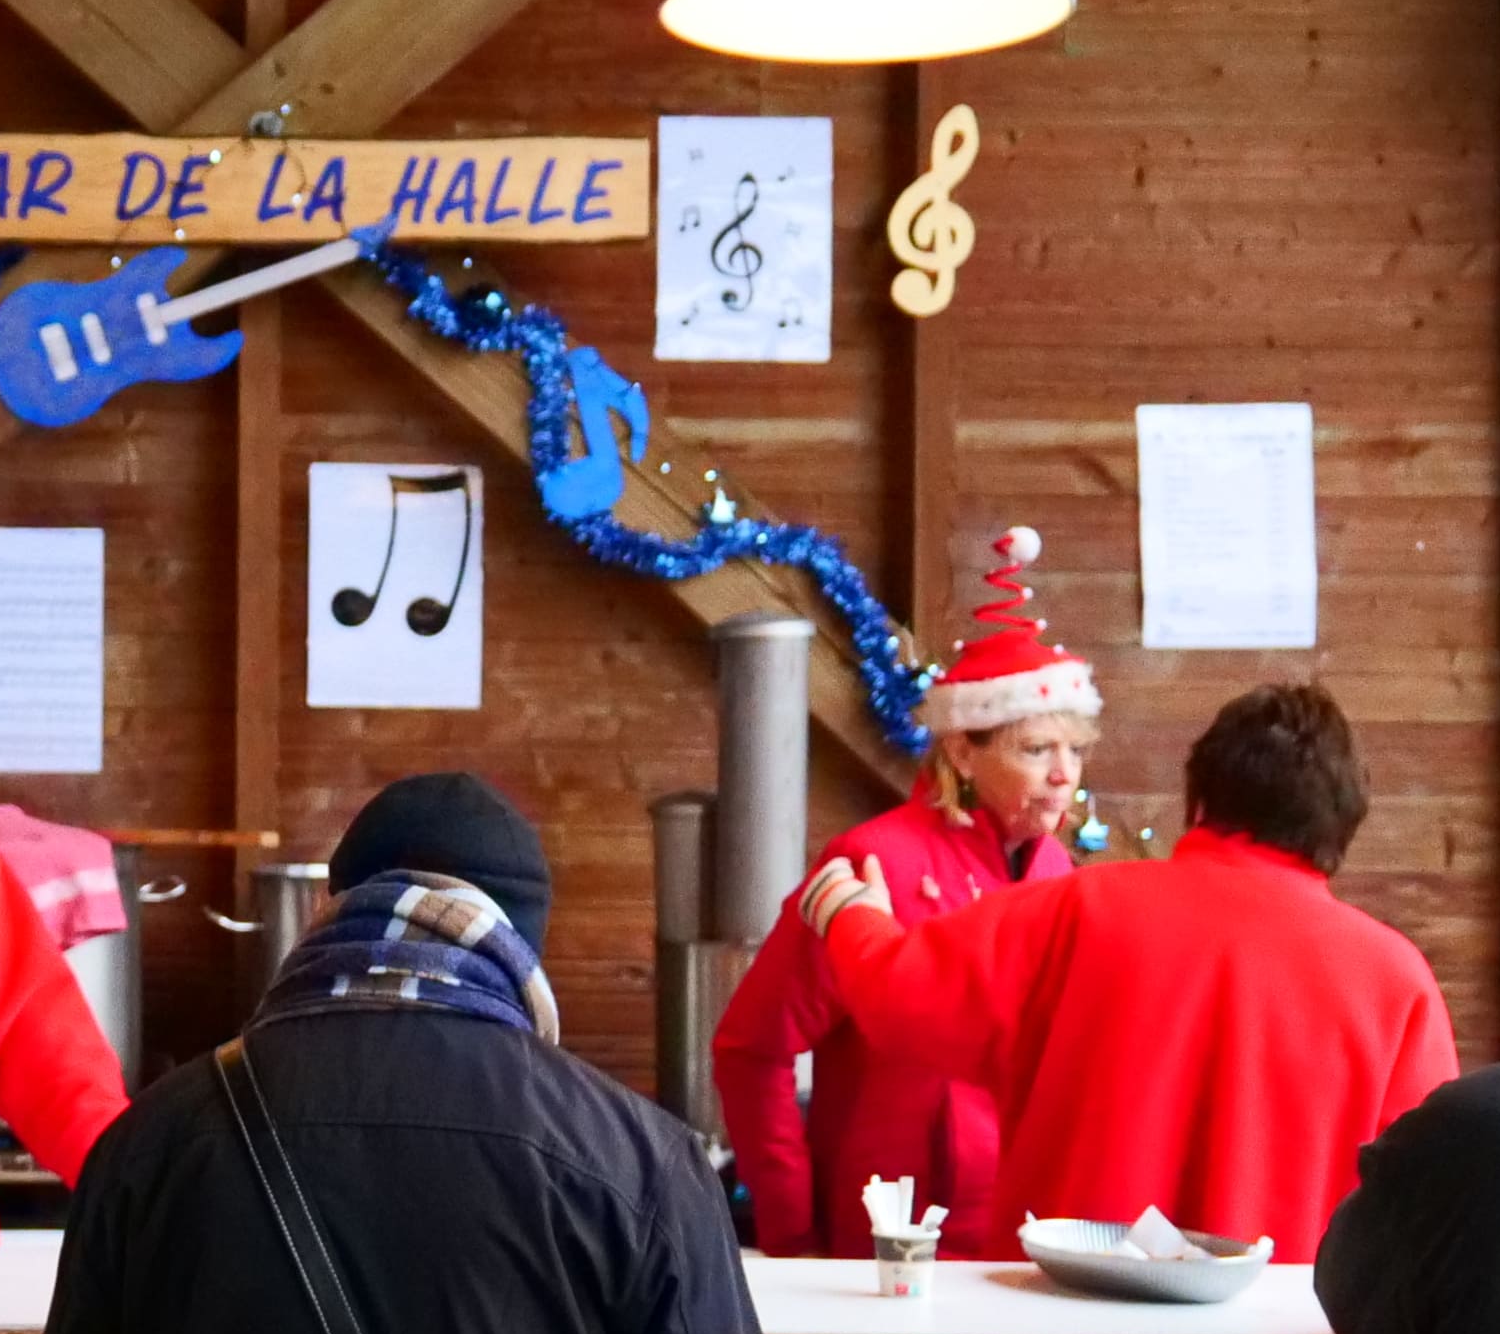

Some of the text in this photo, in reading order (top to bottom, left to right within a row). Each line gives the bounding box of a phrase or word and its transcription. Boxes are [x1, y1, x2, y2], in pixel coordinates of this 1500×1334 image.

[114, 151, 213, 221] DE
[256, 154, 347, 224] LA
[391, 157, 624, 226] HALLE
